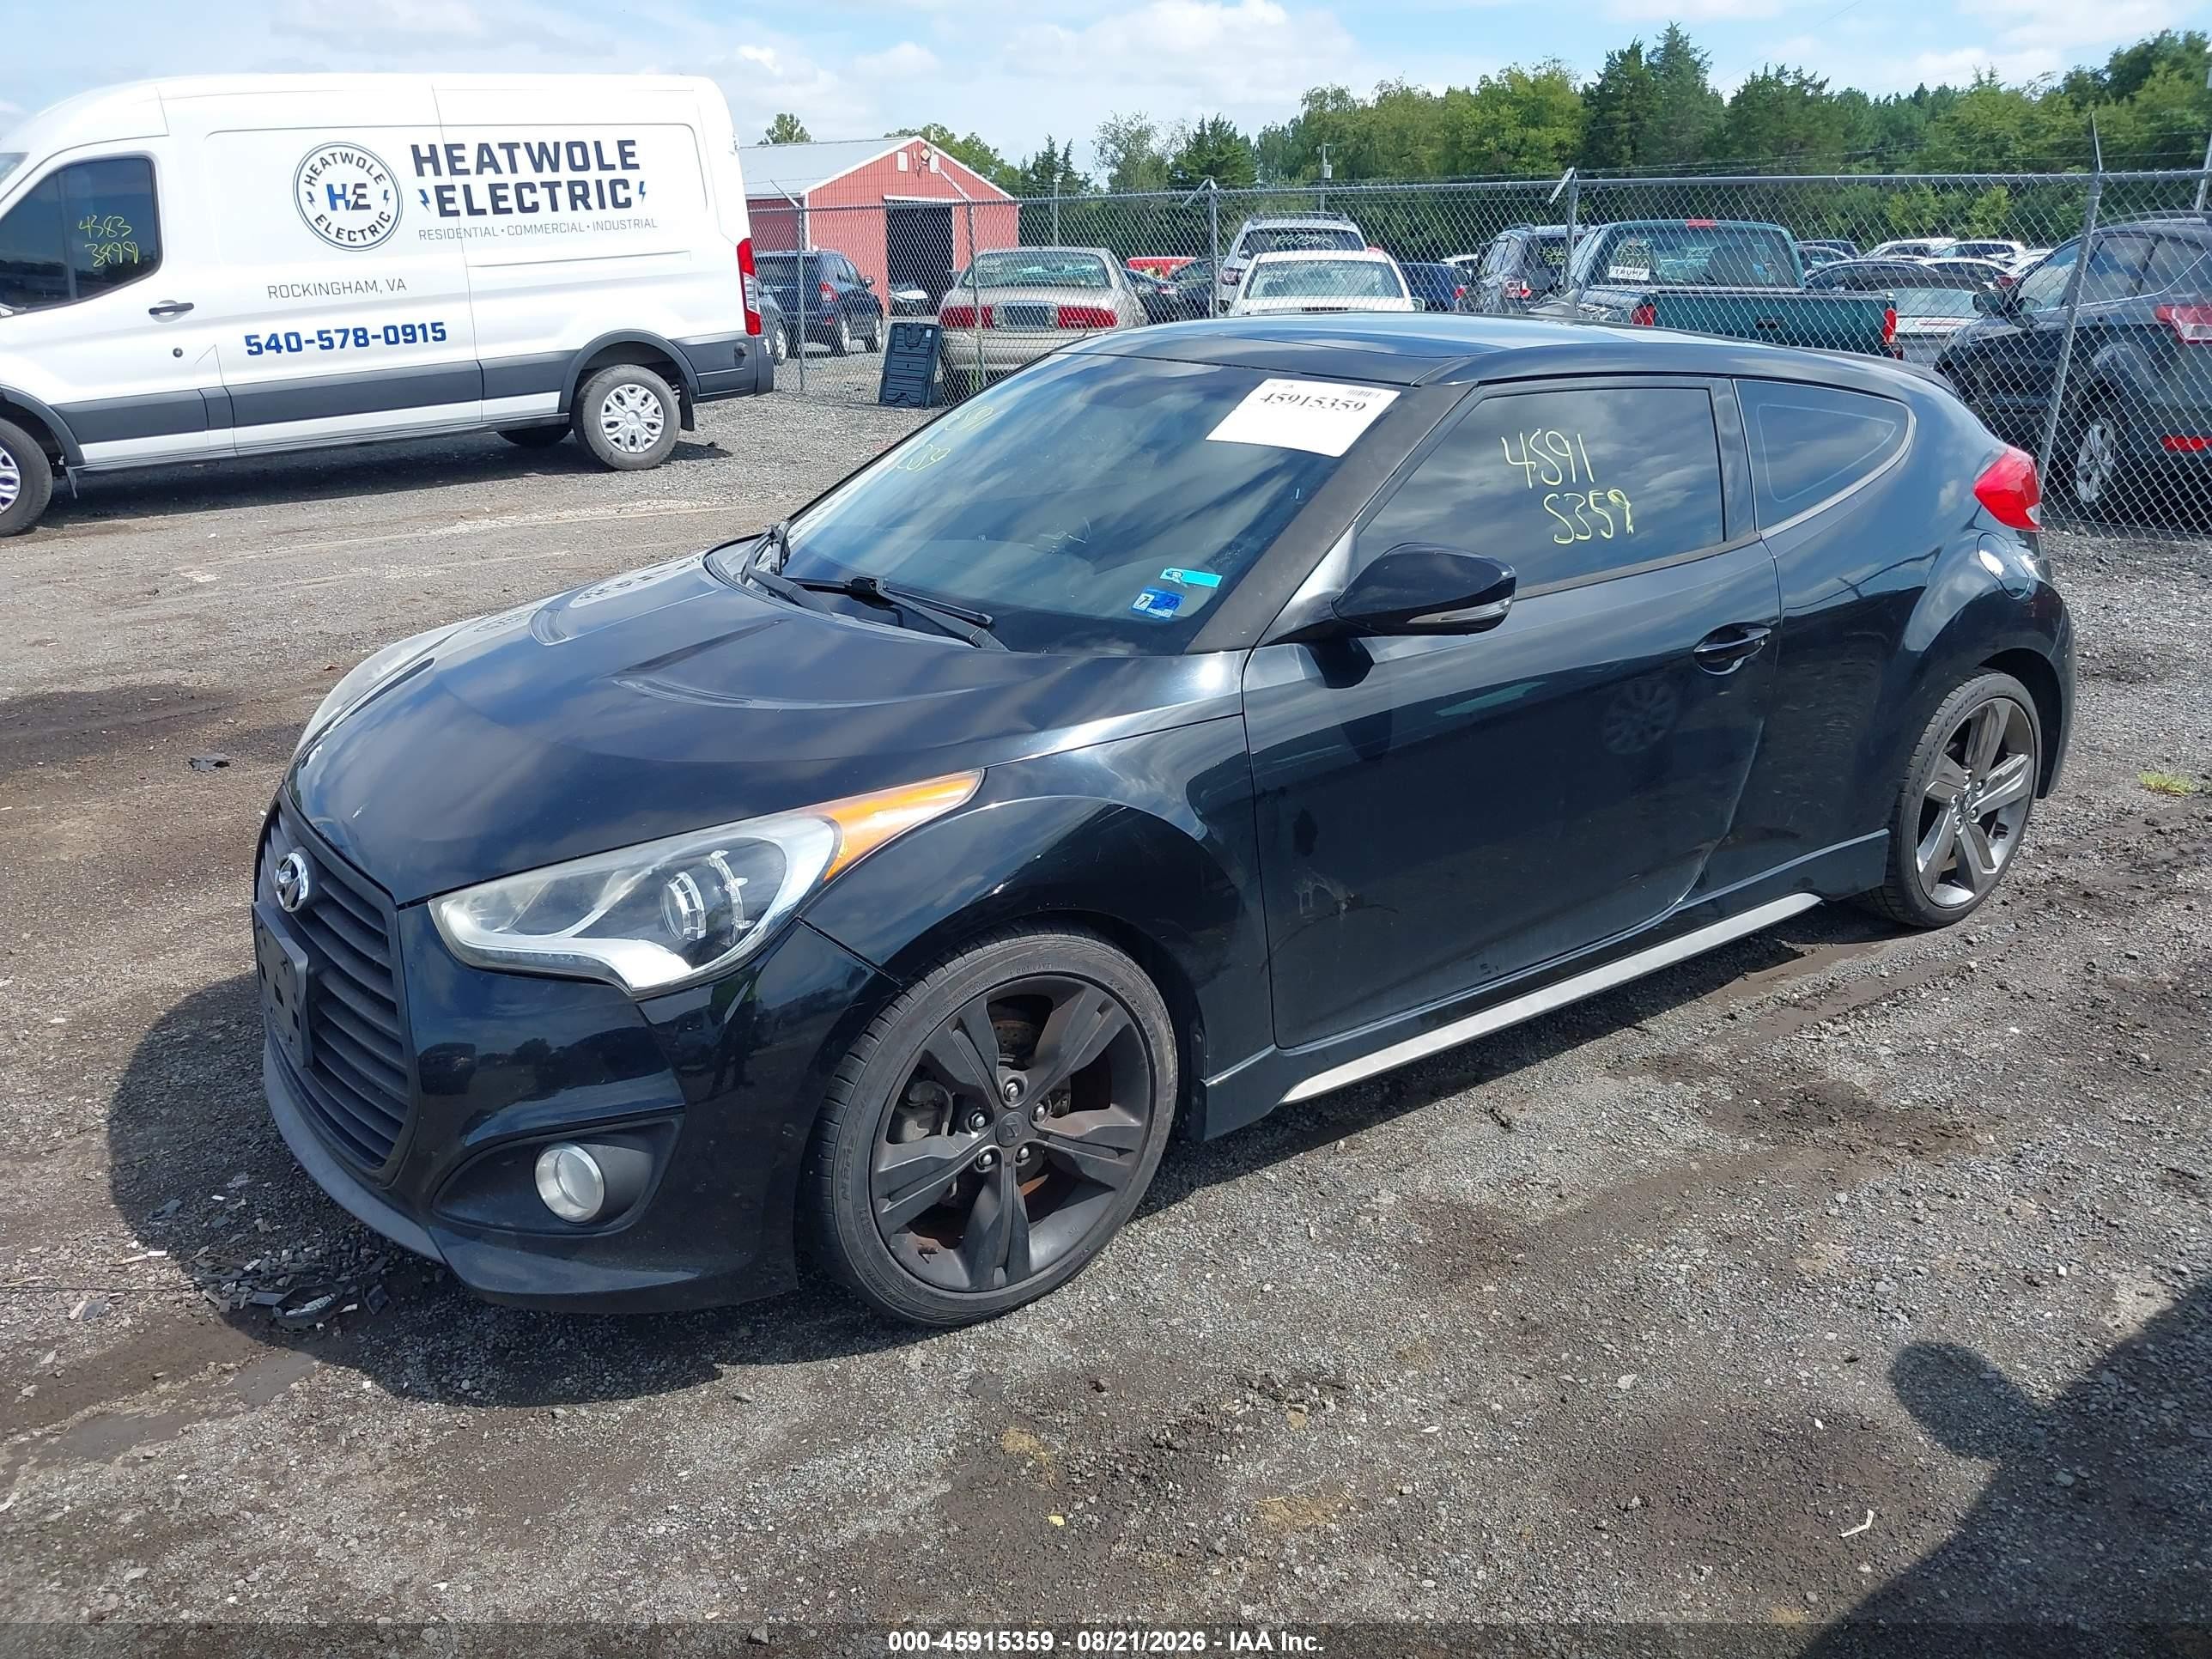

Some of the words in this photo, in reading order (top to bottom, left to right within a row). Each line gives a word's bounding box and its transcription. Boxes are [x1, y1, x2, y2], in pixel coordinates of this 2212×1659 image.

[304, 150, 386, 187] HEATWOLE
[410, 140, 641, 177] HEATWOLE
[326, 183, 372, 211] HE
[434, 179, 633, 217] ELECTRIC
[314, 210, 391, 242] ELECTRIC
[418, 226, 497, 241] RESIDENTIAL
[507, 221, 585, 236] COMMERCIAL
[592, 217, 659, 233] INDUSTRIAL
[267, 279, 383, 300] ROCKINGHAM,
[386, 278, 407, 292] VA
[245, 322, 447, 356] 540-578-0915
[1260, 392, 1367, 412] 45915359
[1501, 428, 1595, 489] 4591
